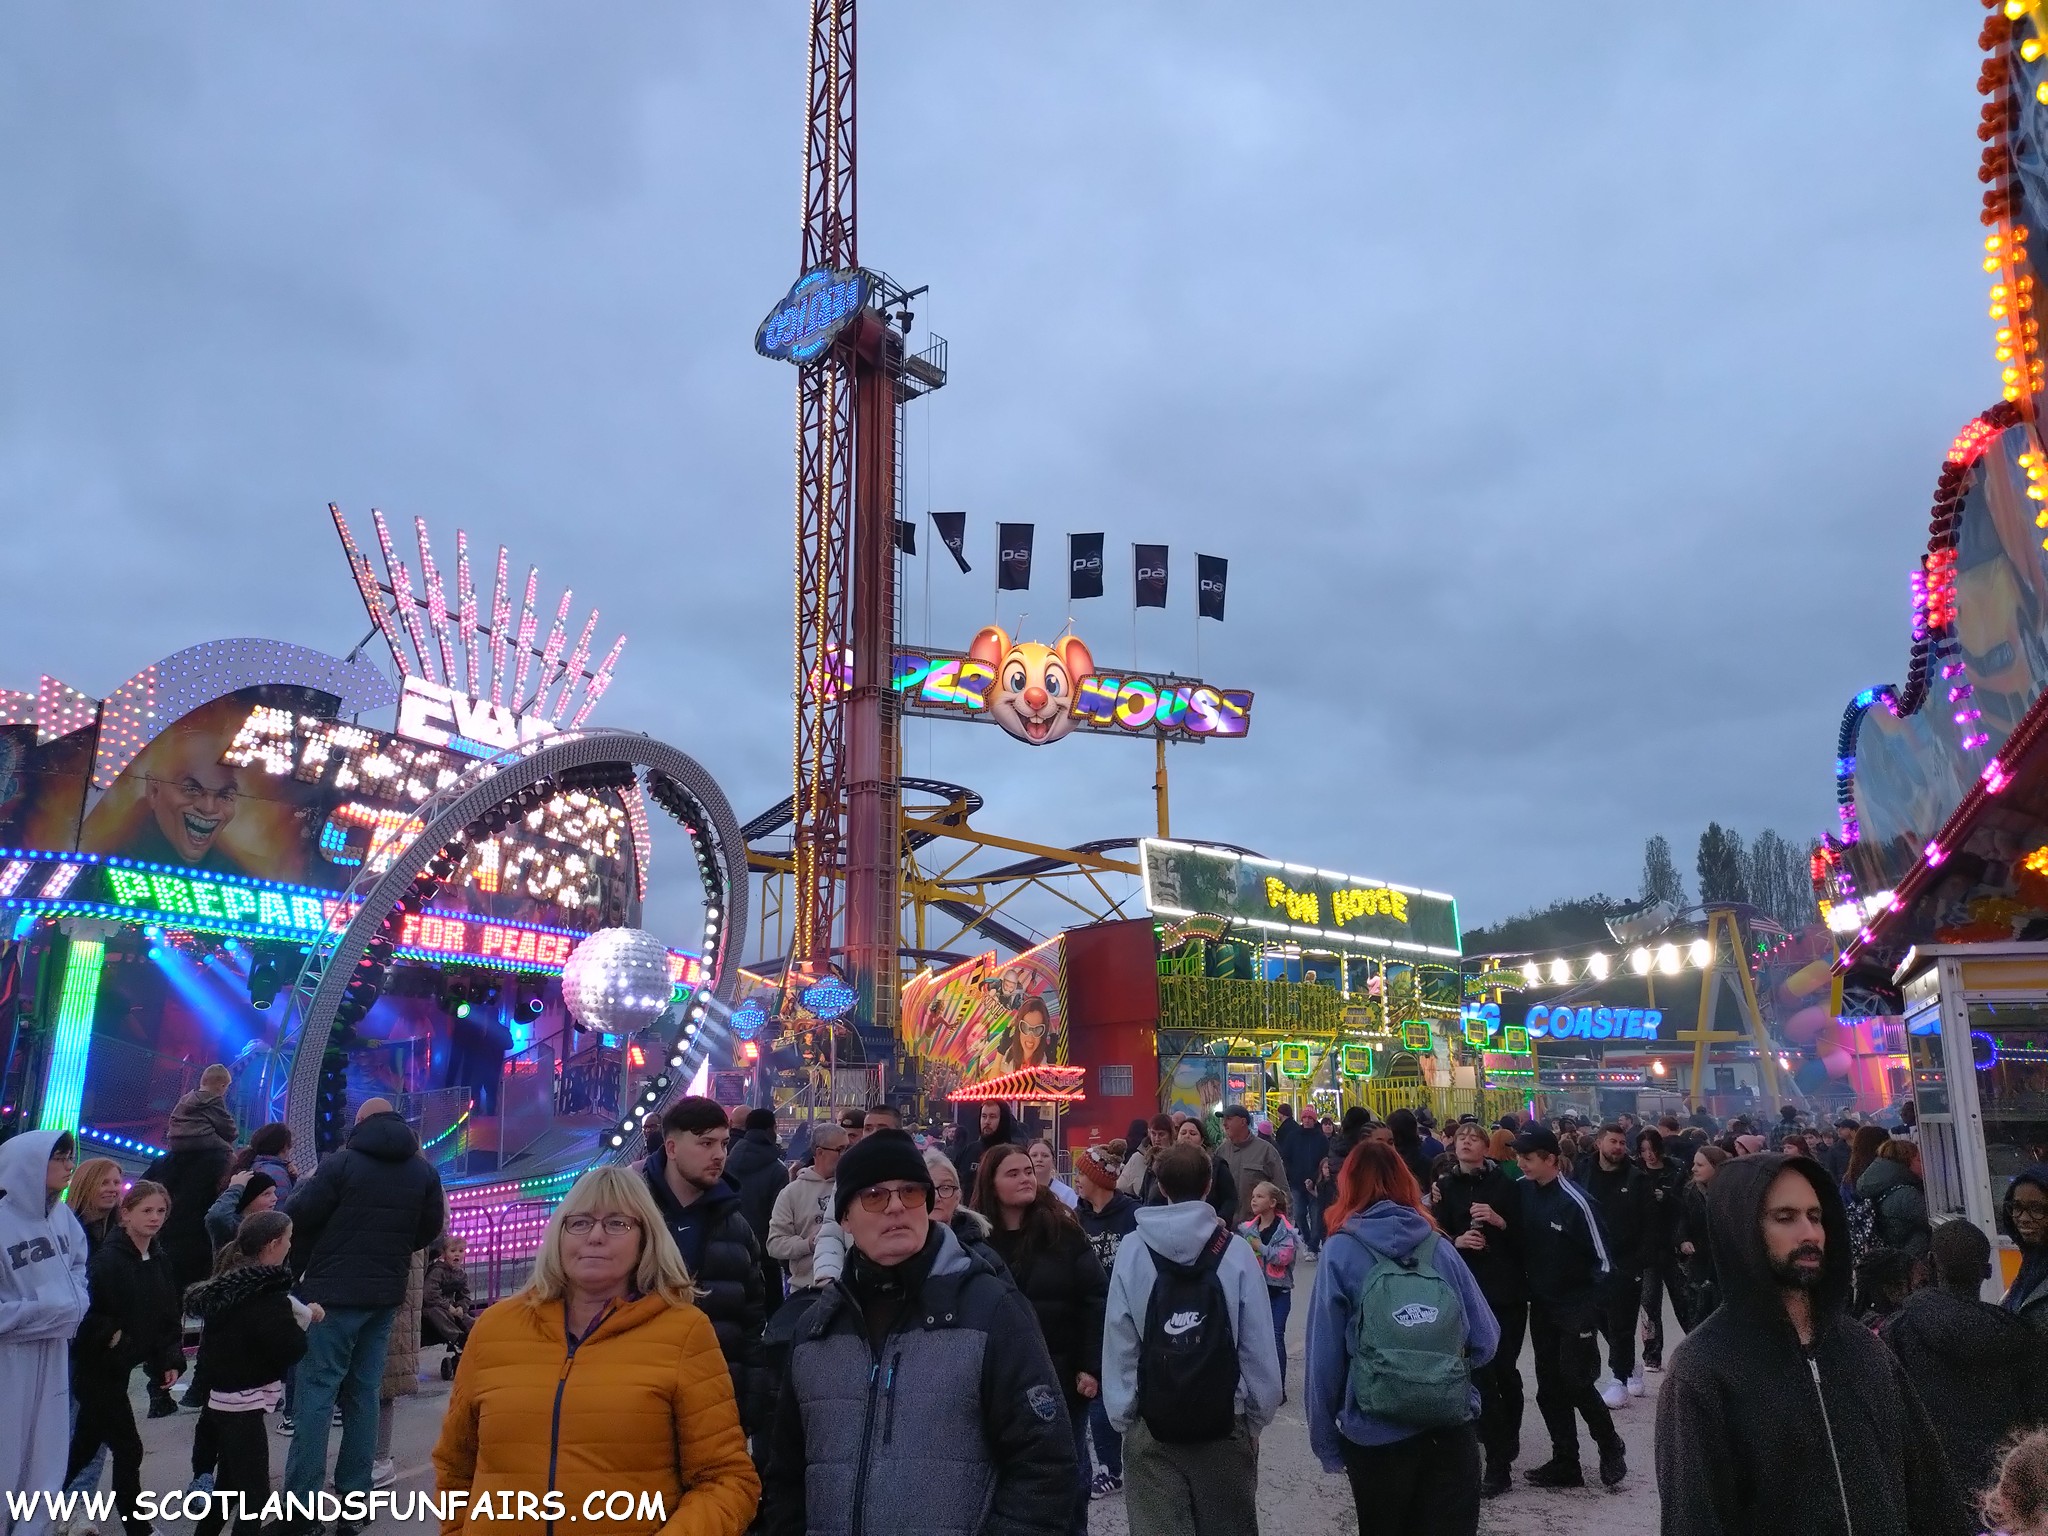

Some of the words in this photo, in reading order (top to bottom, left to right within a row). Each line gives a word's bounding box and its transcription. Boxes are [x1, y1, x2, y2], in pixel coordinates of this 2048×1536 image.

[1074, 677, 1249, 734] MOUSE
[1265, 876, 1319, 925] FUN
[1332, 887, 1408, 927] HOUSE
[402, 913, 466, 952] FOR
[482, 924, 571, 965] PEACE
[1526, 1004, 1663, 1040] COASTER
[1171, 1312, 1200, 1326] NIKE
[1171, 1337, 1201, 1345] AIR
